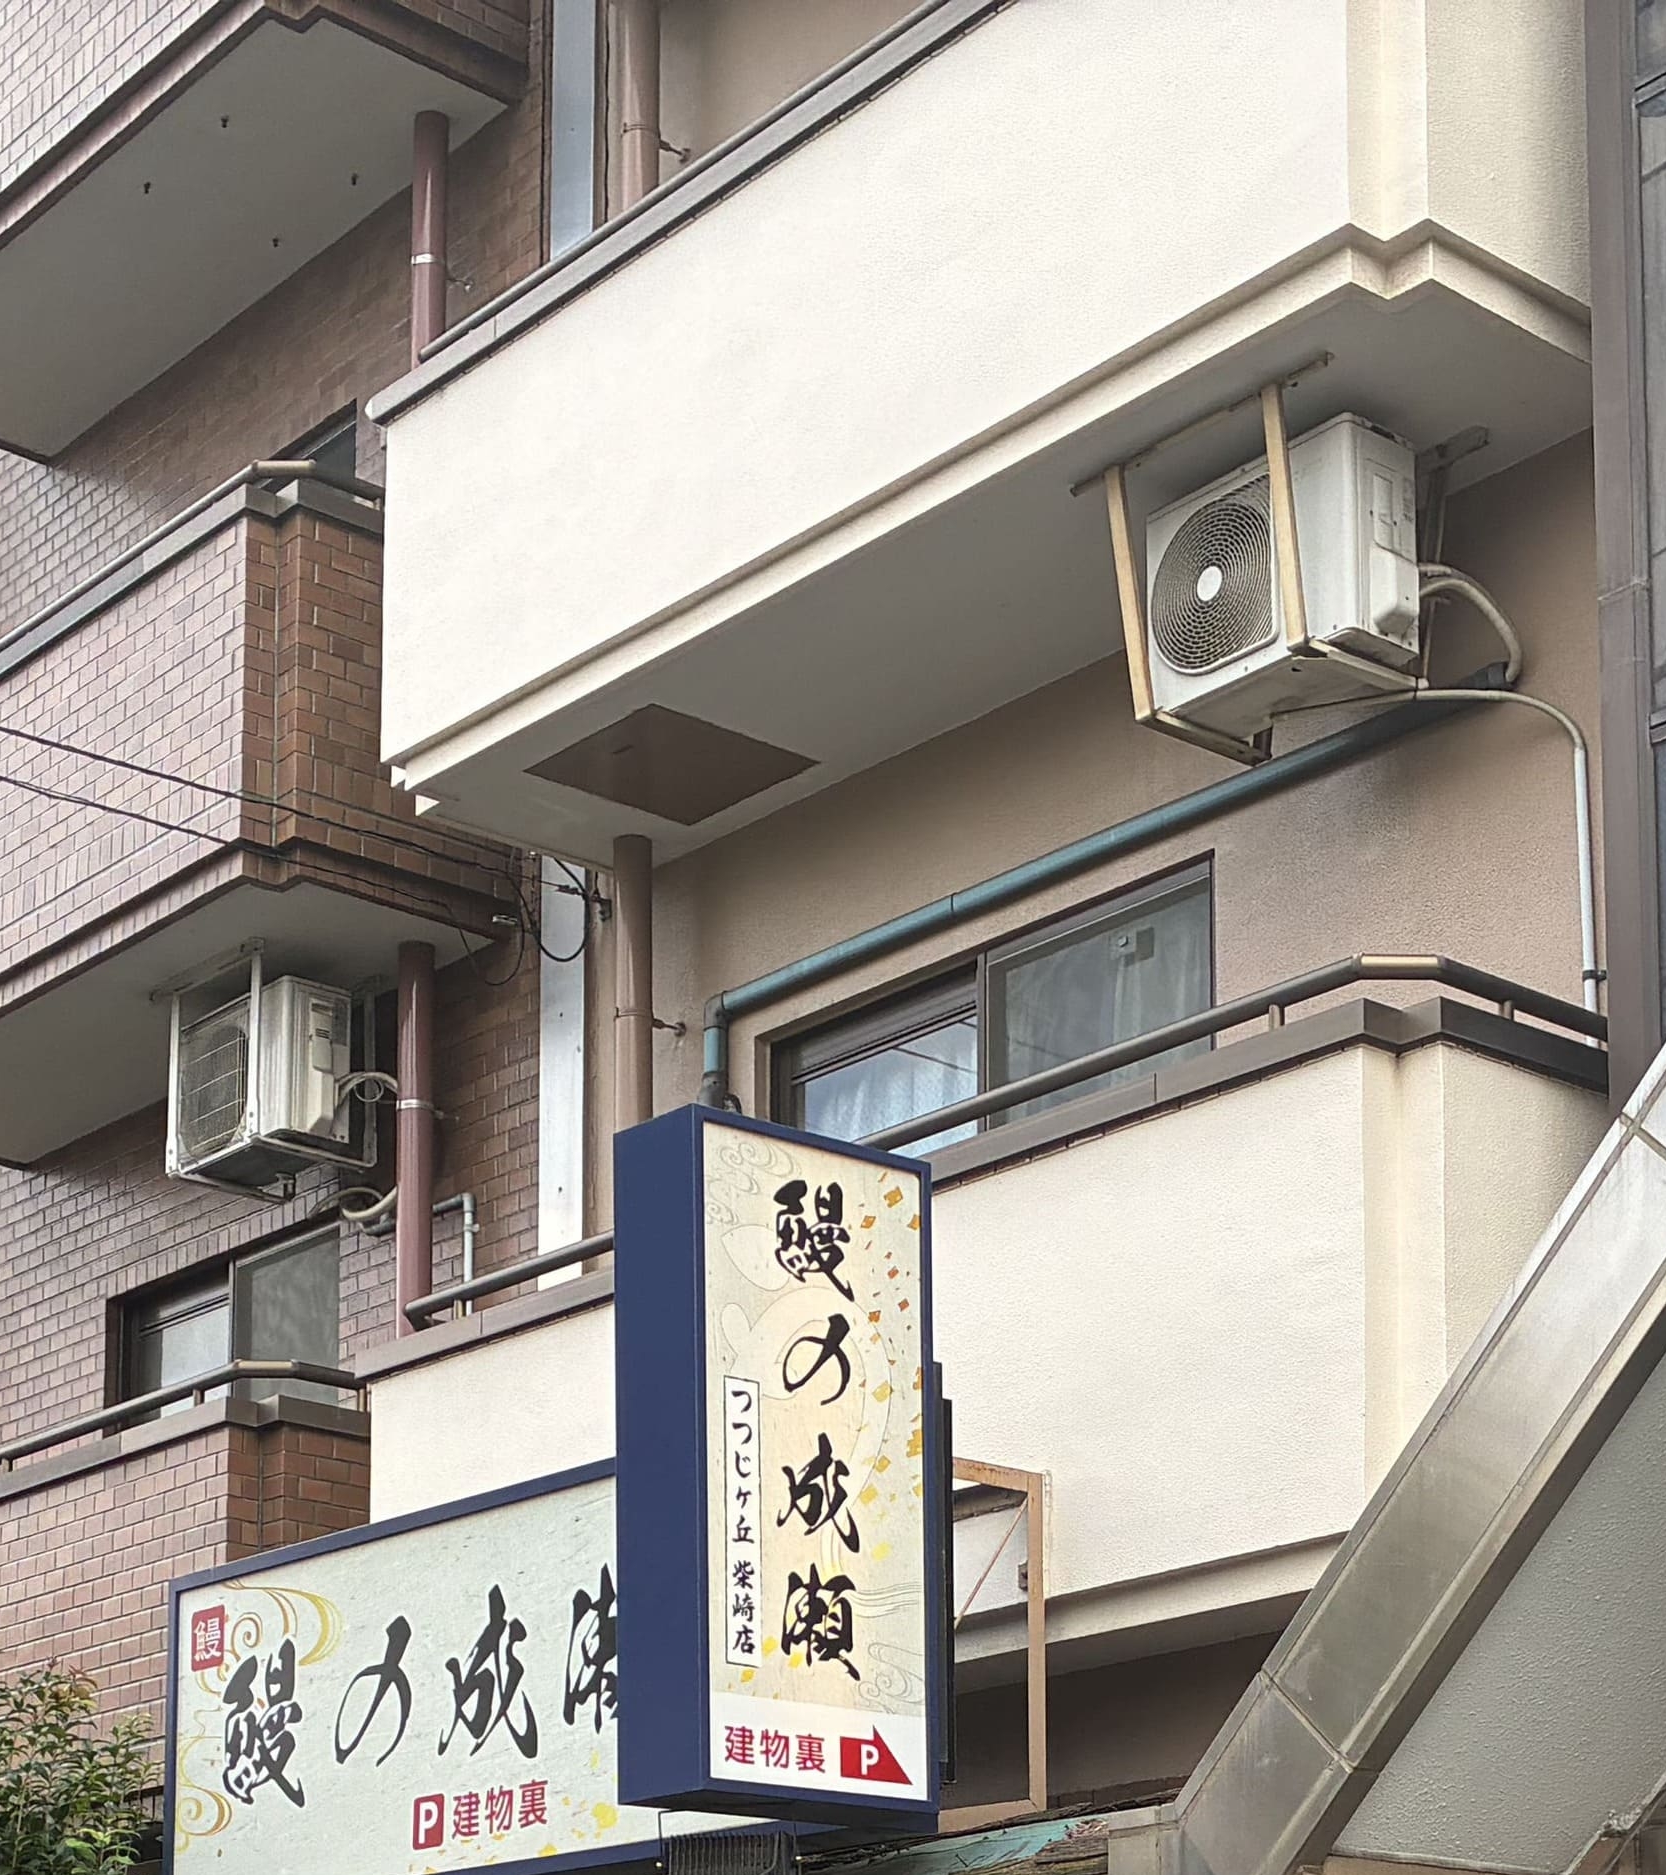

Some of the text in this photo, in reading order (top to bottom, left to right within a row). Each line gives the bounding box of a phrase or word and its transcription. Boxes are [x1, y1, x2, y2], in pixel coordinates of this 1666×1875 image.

[773, 1180, 861, 1682] 鰻の成瀬
[731, 1560, 756, 1655] 柴崎店
[724, 1724, 826, 1774] 建物裏
[452, 1780, 549, 1839] 建物裏
